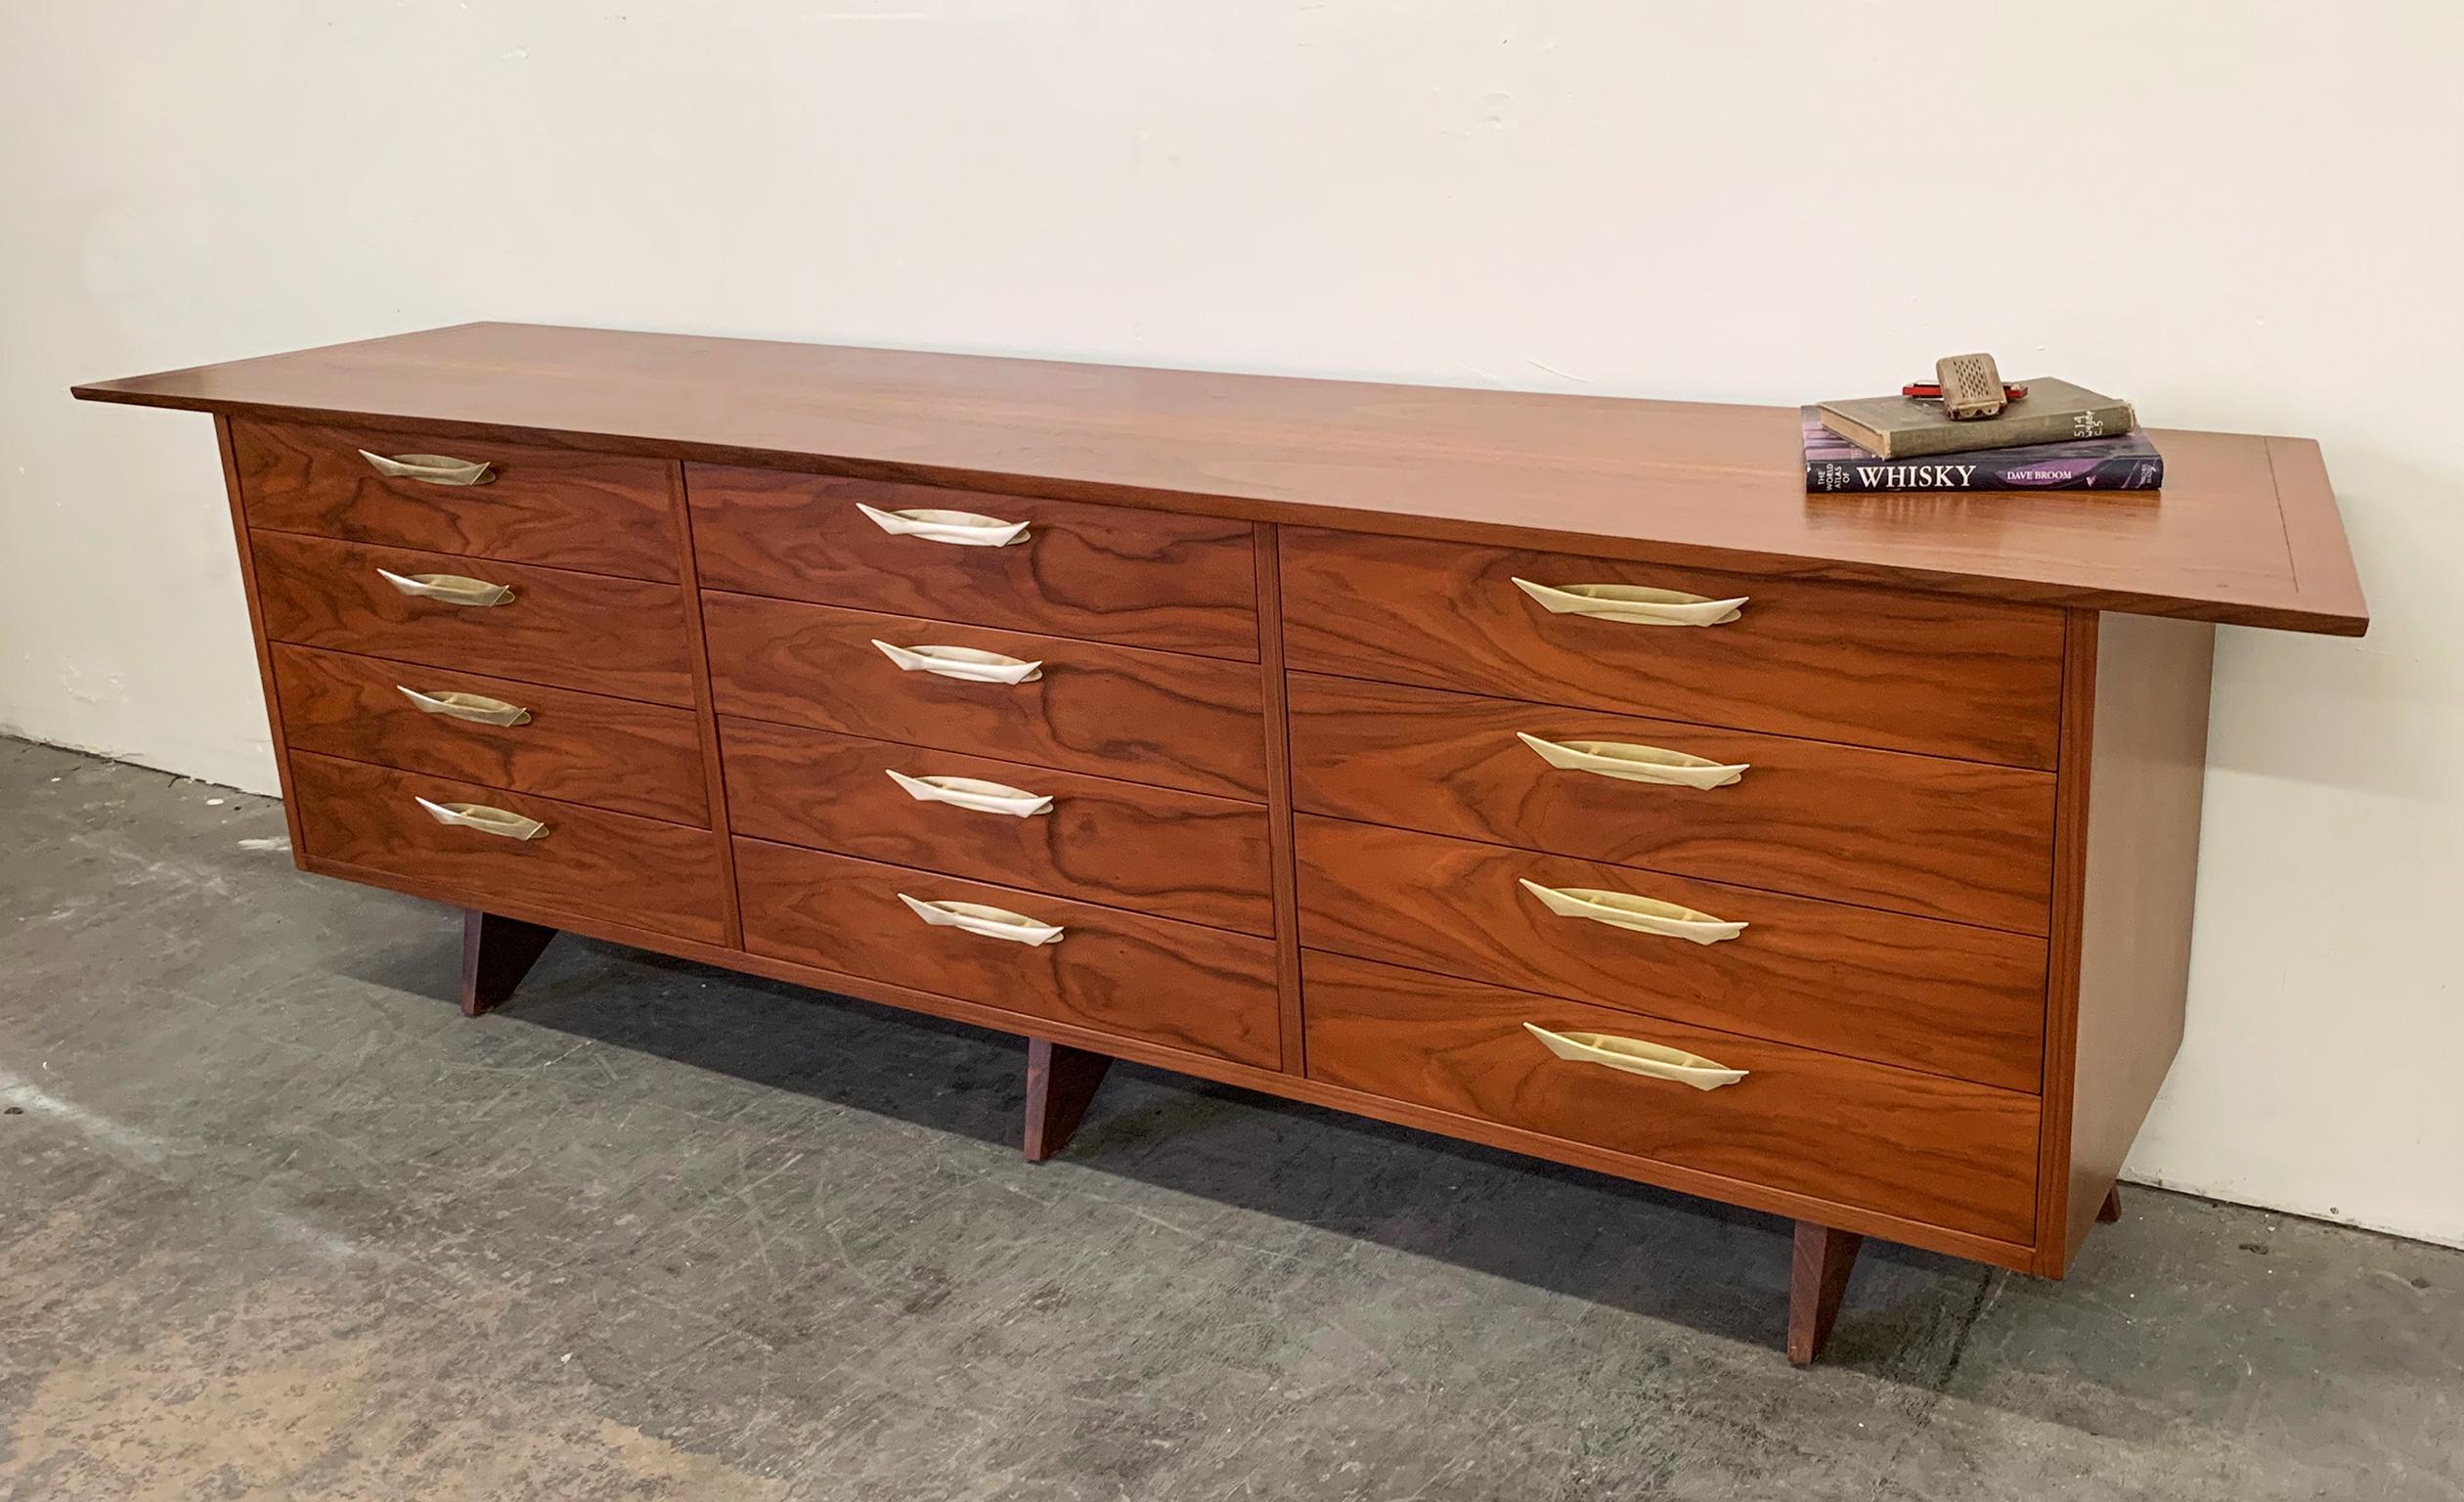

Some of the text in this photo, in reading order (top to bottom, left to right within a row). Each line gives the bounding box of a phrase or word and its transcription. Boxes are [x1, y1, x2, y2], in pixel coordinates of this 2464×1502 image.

[2073, 416, 2085, 437] 514
[1842, 472, 1850, 483] OF
[1856, 465, 1976, 488] WHISKY
[2006, 470, 2072, 480] DAVE BROOM
